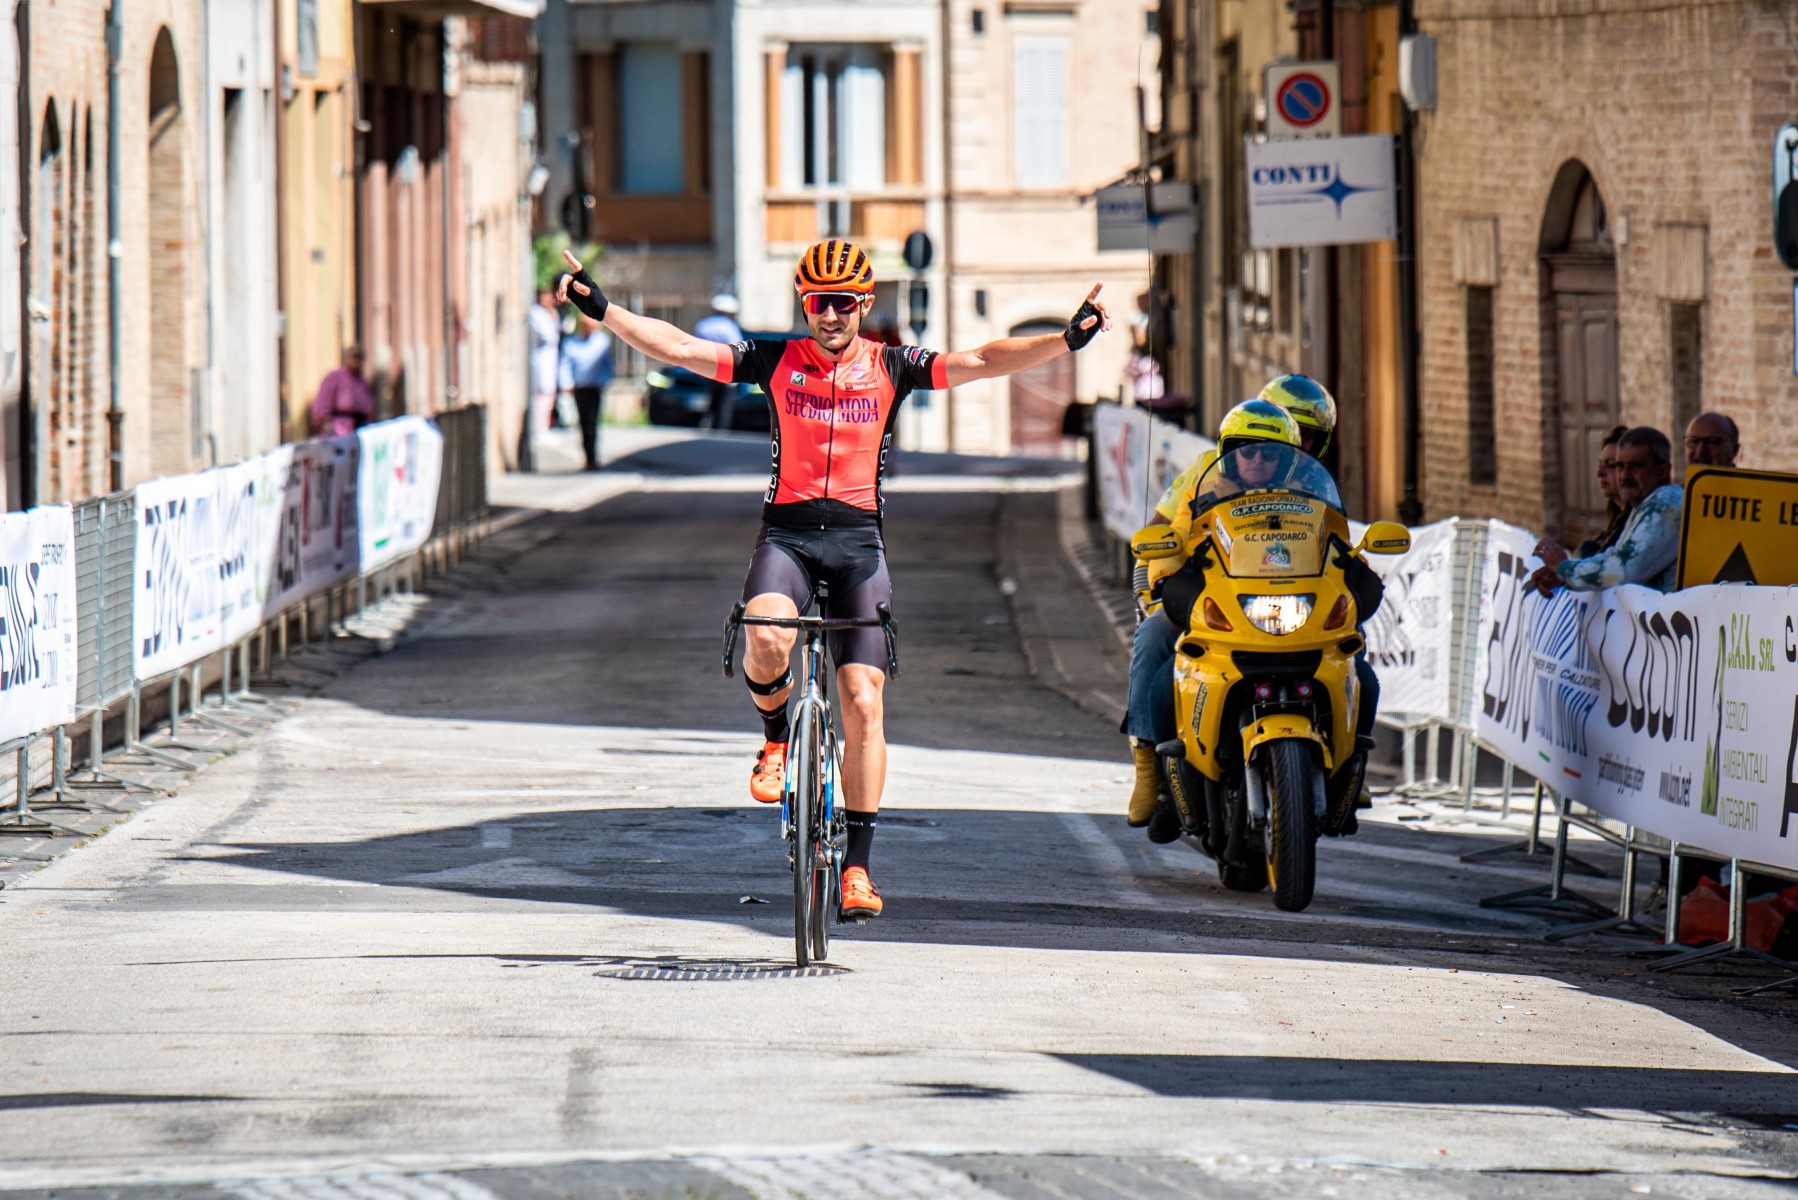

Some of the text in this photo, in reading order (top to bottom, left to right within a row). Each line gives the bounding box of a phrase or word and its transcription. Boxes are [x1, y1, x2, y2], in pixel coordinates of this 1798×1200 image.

[1253, 164, 1330, 185] CONTI
[785, 388, 879, 424] STUDIO MODA
[1230, 499, 1247, 507] TEAM
[1233, 504, 1312, 515] G.P. CAPODARCO
[1702, 494, 1798, 526] TUTTE LE
[1244, 532, 1307, 542] G.C. CAPODARCO
[1759, 638, 1775, 672] SRL
[1725, 700, 1748, 732] SERVIZI
[1722, 748, 1768, 783] AMBIENTALI
[1719, 796, 1758, 832] INTEGRATI
